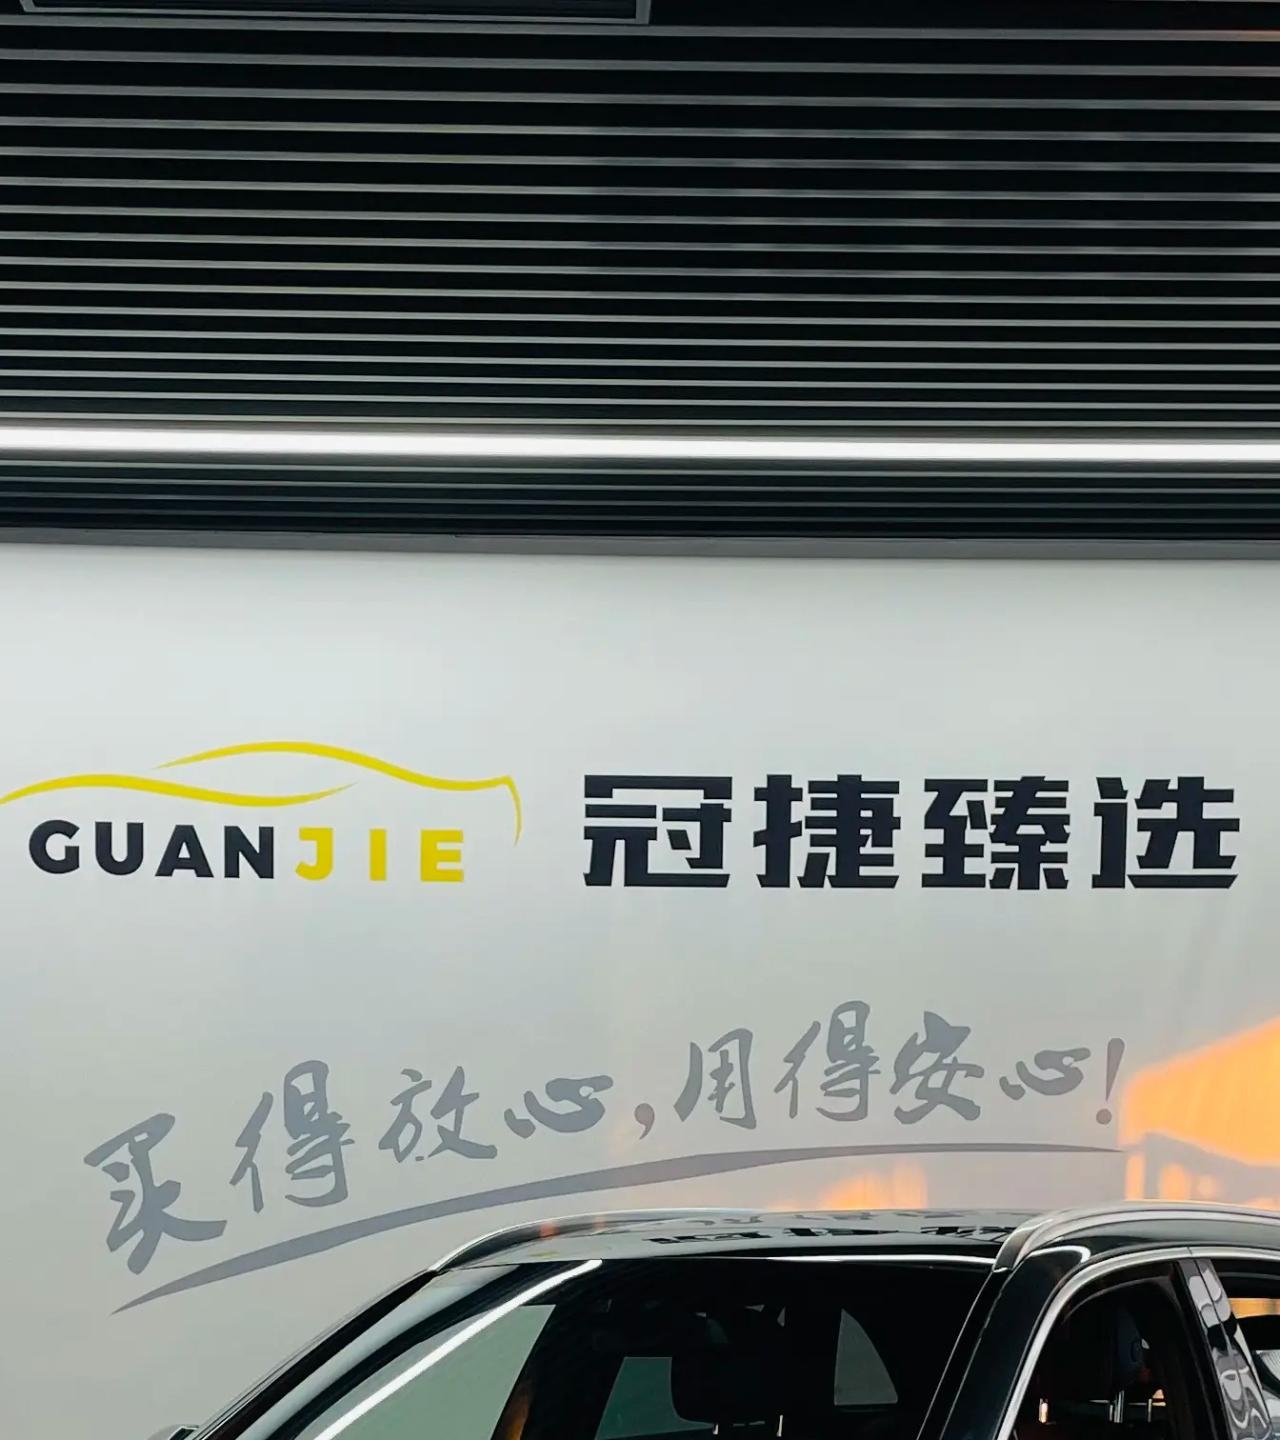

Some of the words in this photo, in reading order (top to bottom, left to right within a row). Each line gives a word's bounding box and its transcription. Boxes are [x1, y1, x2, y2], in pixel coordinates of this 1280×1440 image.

[28, 819, 465, 884] GUANJIE
[583, 774, 1241, 891] 冠捷臻选
